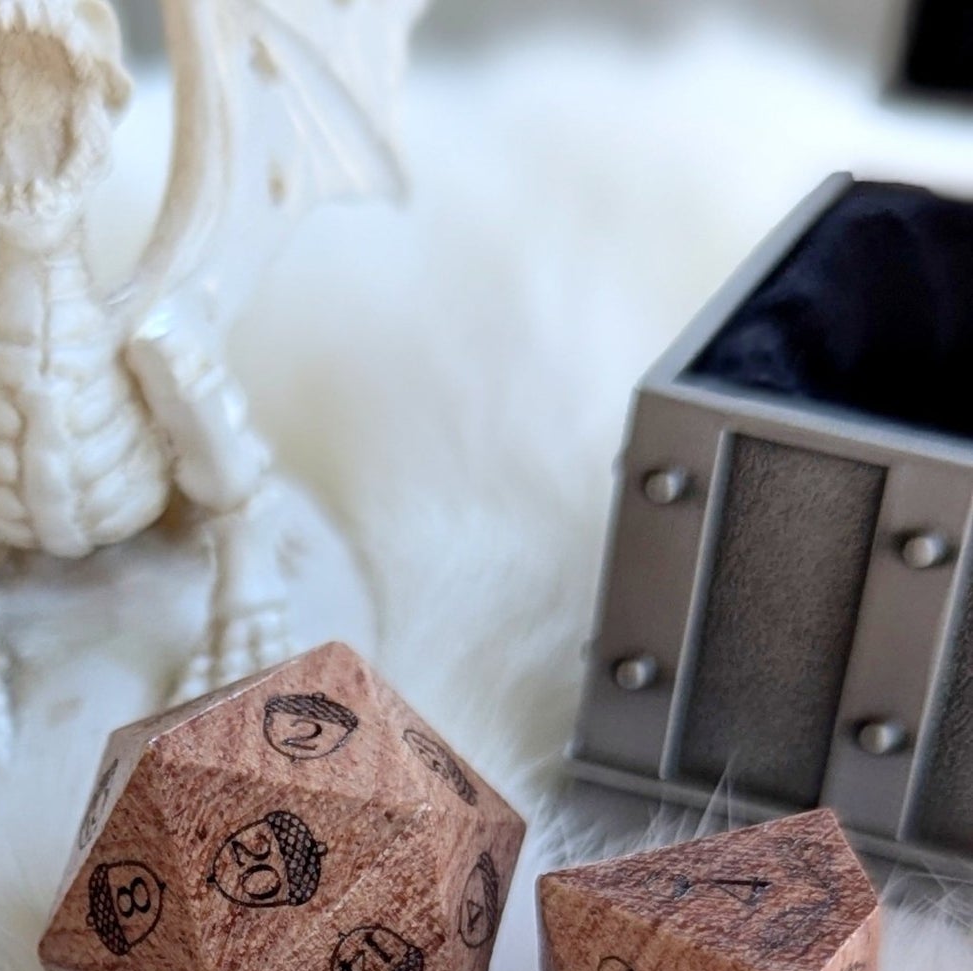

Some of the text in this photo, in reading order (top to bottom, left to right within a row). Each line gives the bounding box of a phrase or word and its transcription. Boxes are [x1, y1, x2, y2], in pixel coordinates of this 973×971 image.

[284, 718, 323, 751] 2
[230, 831, 283, 900] 20
[115, 876, 152, 920] 8
